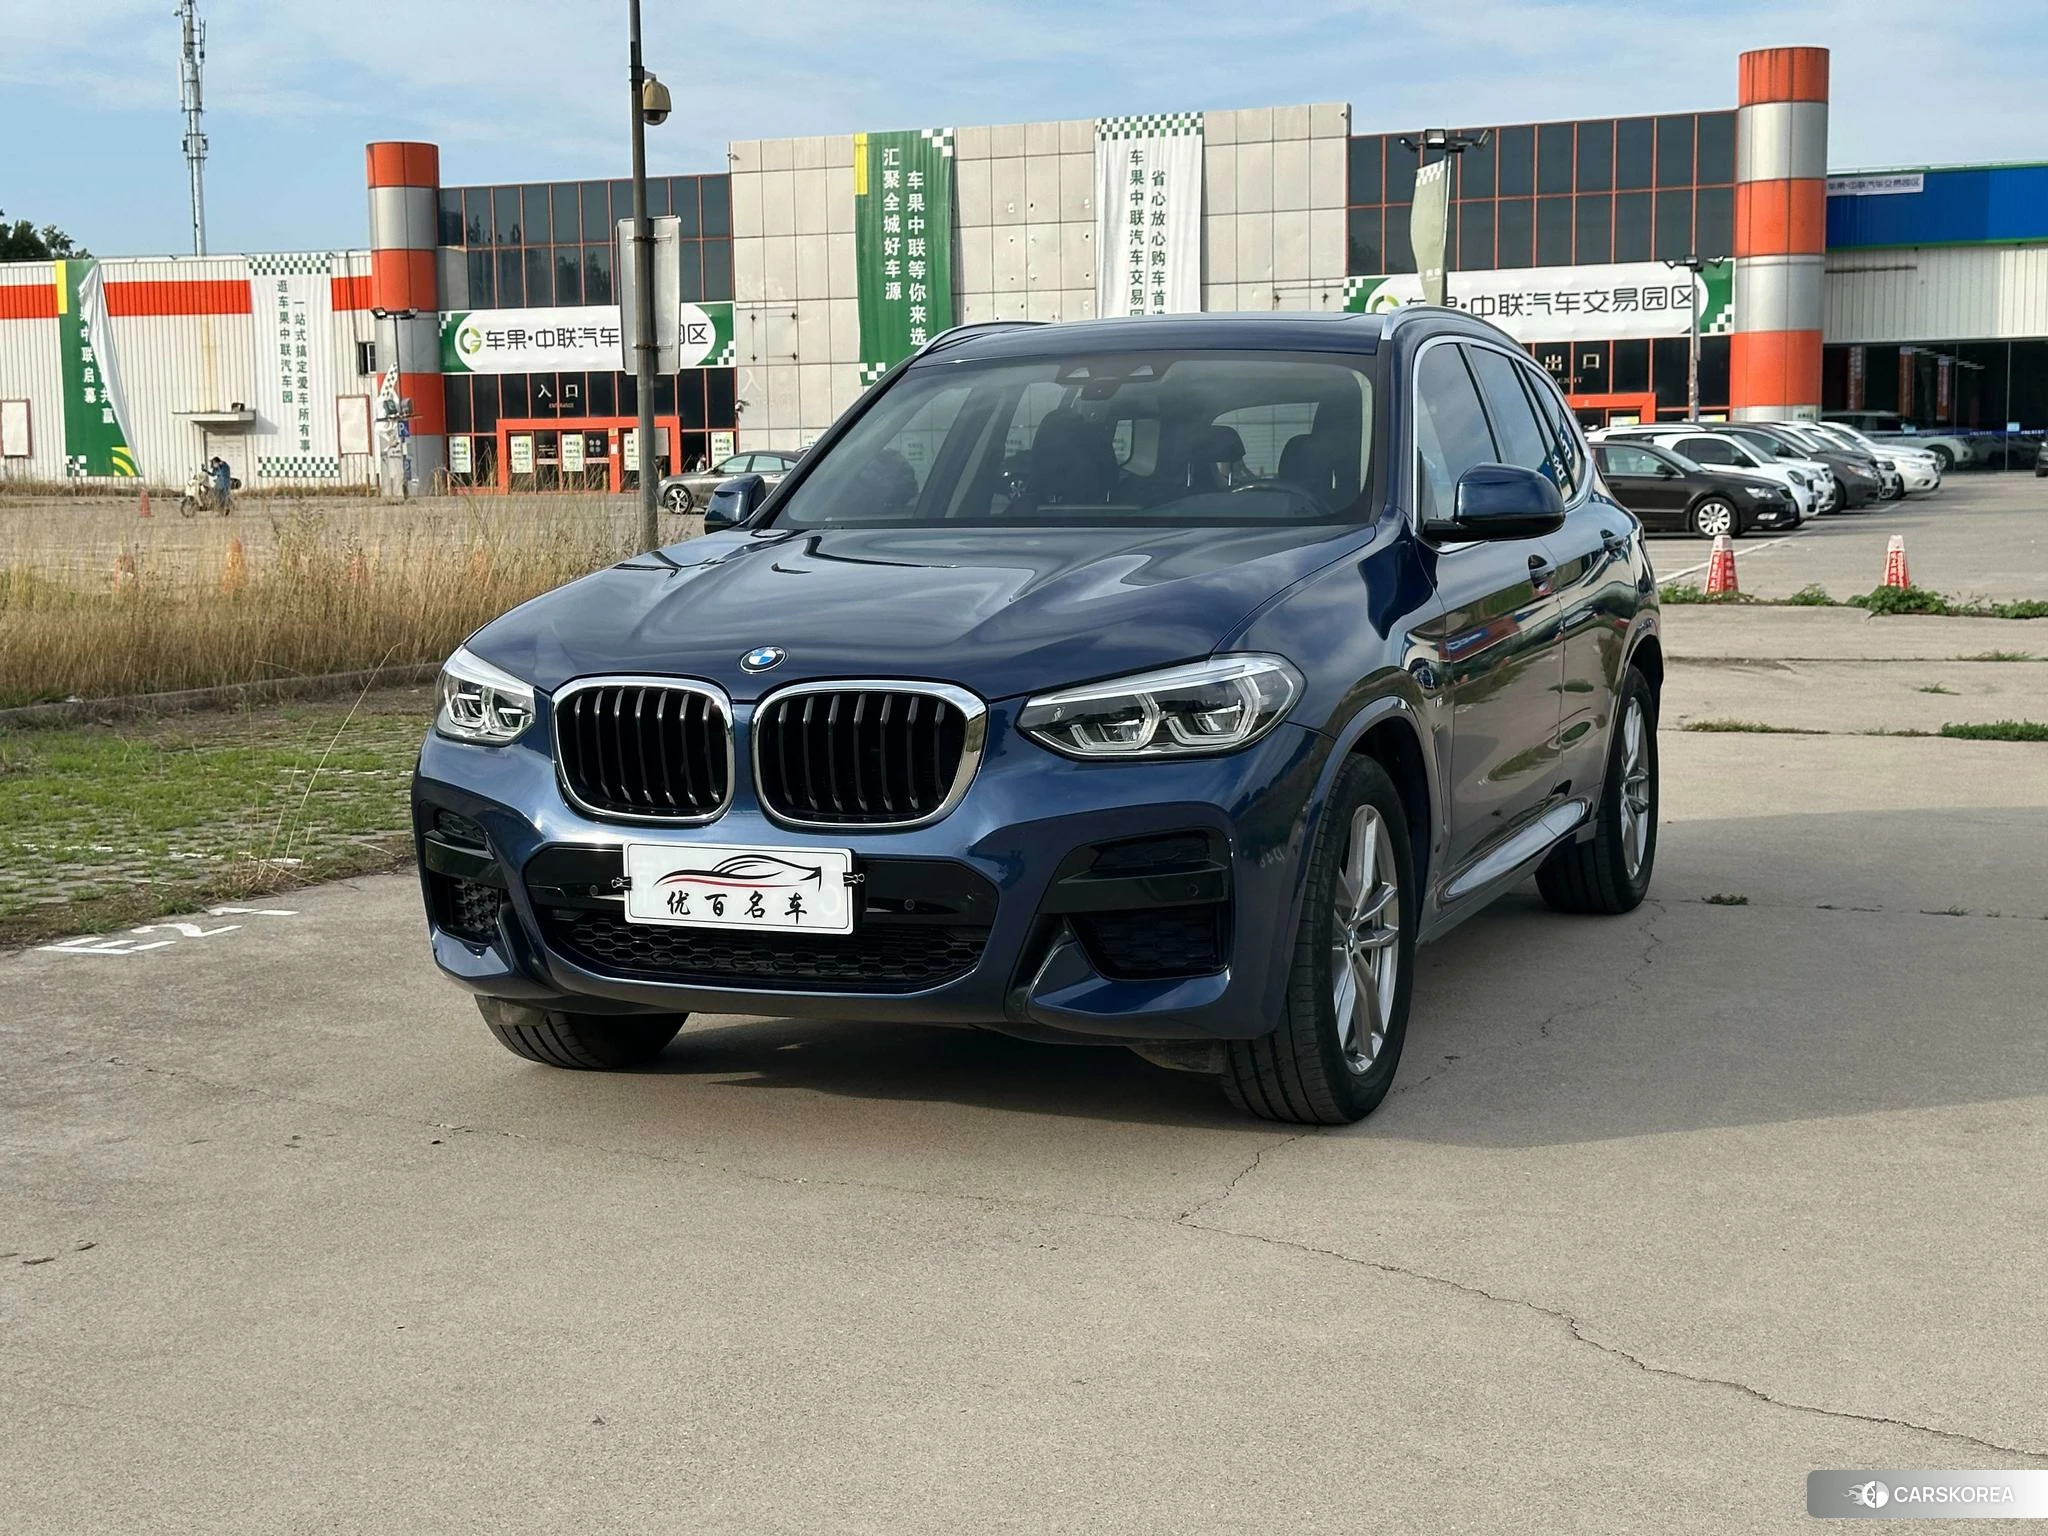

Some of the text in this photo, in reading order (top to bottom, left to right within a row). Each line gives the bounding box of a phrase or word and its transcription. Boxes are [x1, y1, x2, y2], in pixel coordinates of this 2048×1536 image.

[883, 148, 902, 301] 汇聚全城好车源
[907, 170, 928, 346] 车果中联等你来选
[1151, 169, 1167, 315] 省心放心购车首
[276, 279, 294, 404] 逛车果中联汽车园
[293, 300, 311, 454] 一站式搞定爱车所有事
[537, 383, 578, 398] 入口
[1544, 353, 1600, 371] 出口
[666, 889, 808, 924] 优百名车
